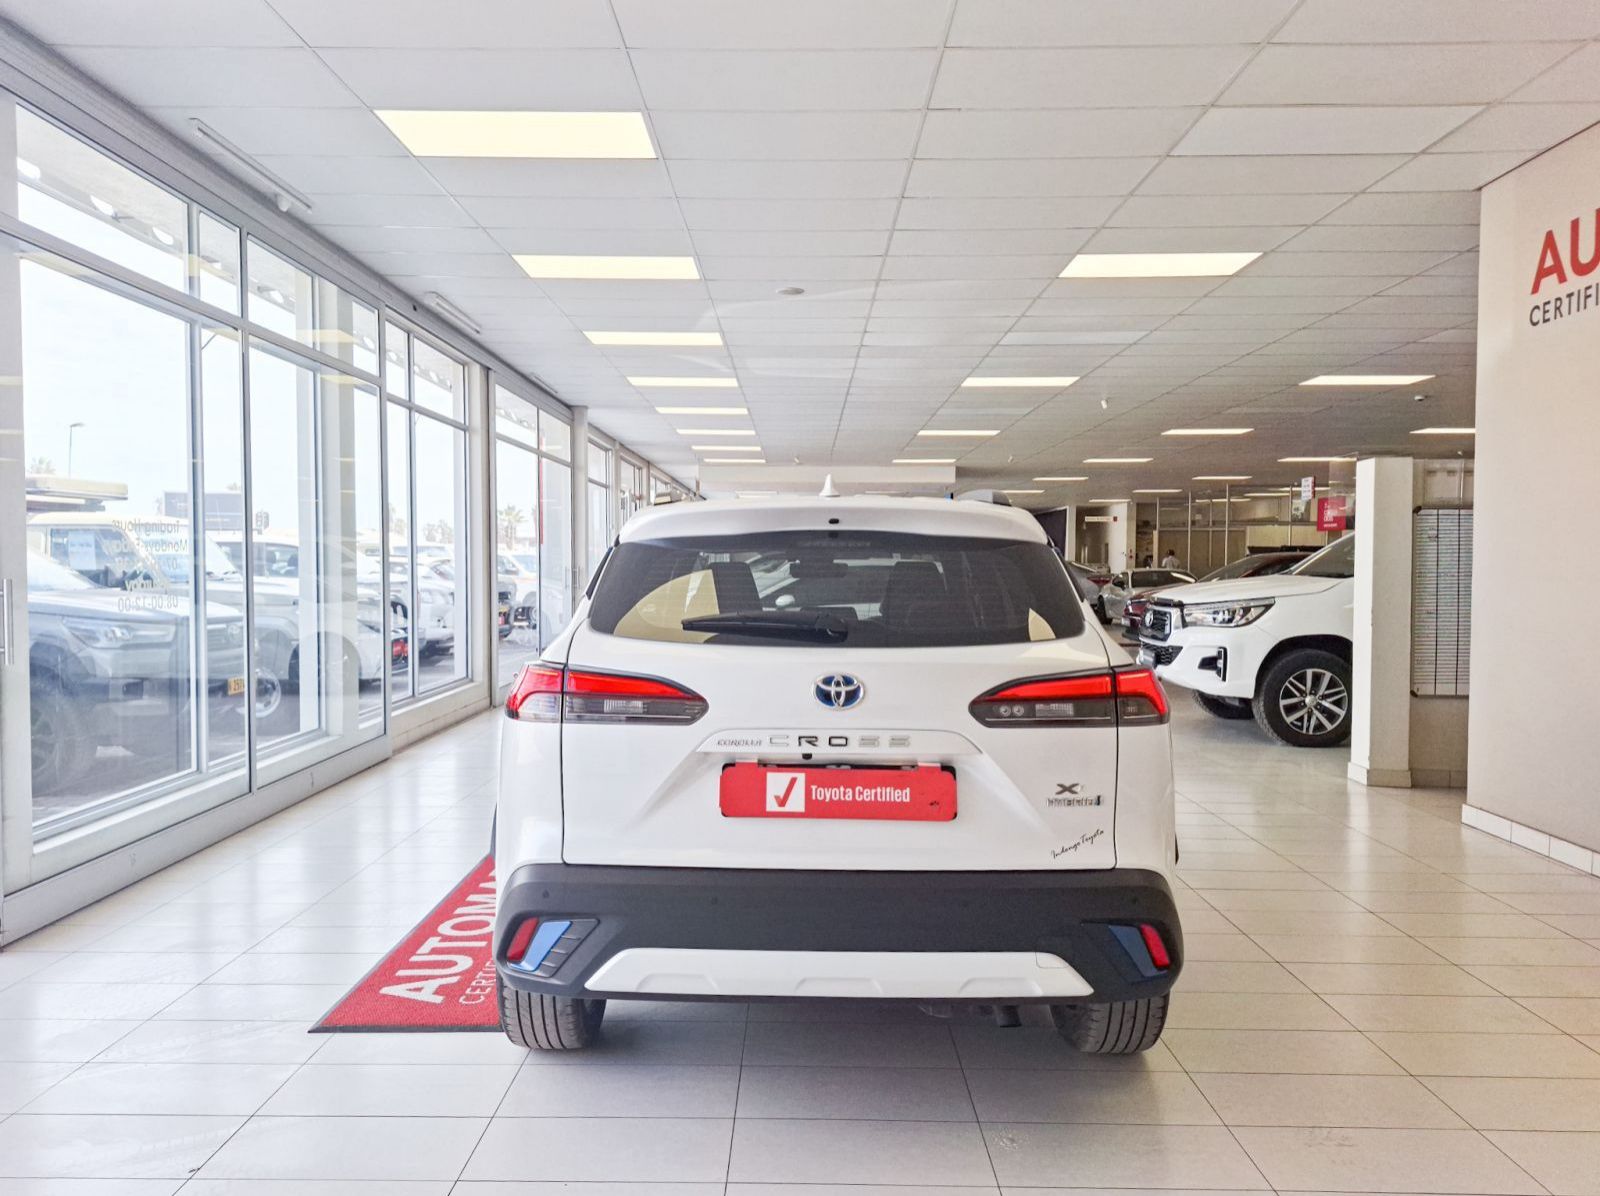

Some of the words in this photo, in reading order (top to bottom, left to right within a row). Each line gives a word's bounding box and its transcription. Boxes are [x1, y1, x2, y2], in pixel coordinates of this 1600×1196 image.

[769, 735, 911, 748] CROSS
[811, 785, 852, 802] Toyota
[855, 786, 910, 803] Certified
[1080, 828, 1104, 845] Toyota
[379, 867, 496, 1004] AUTOM
